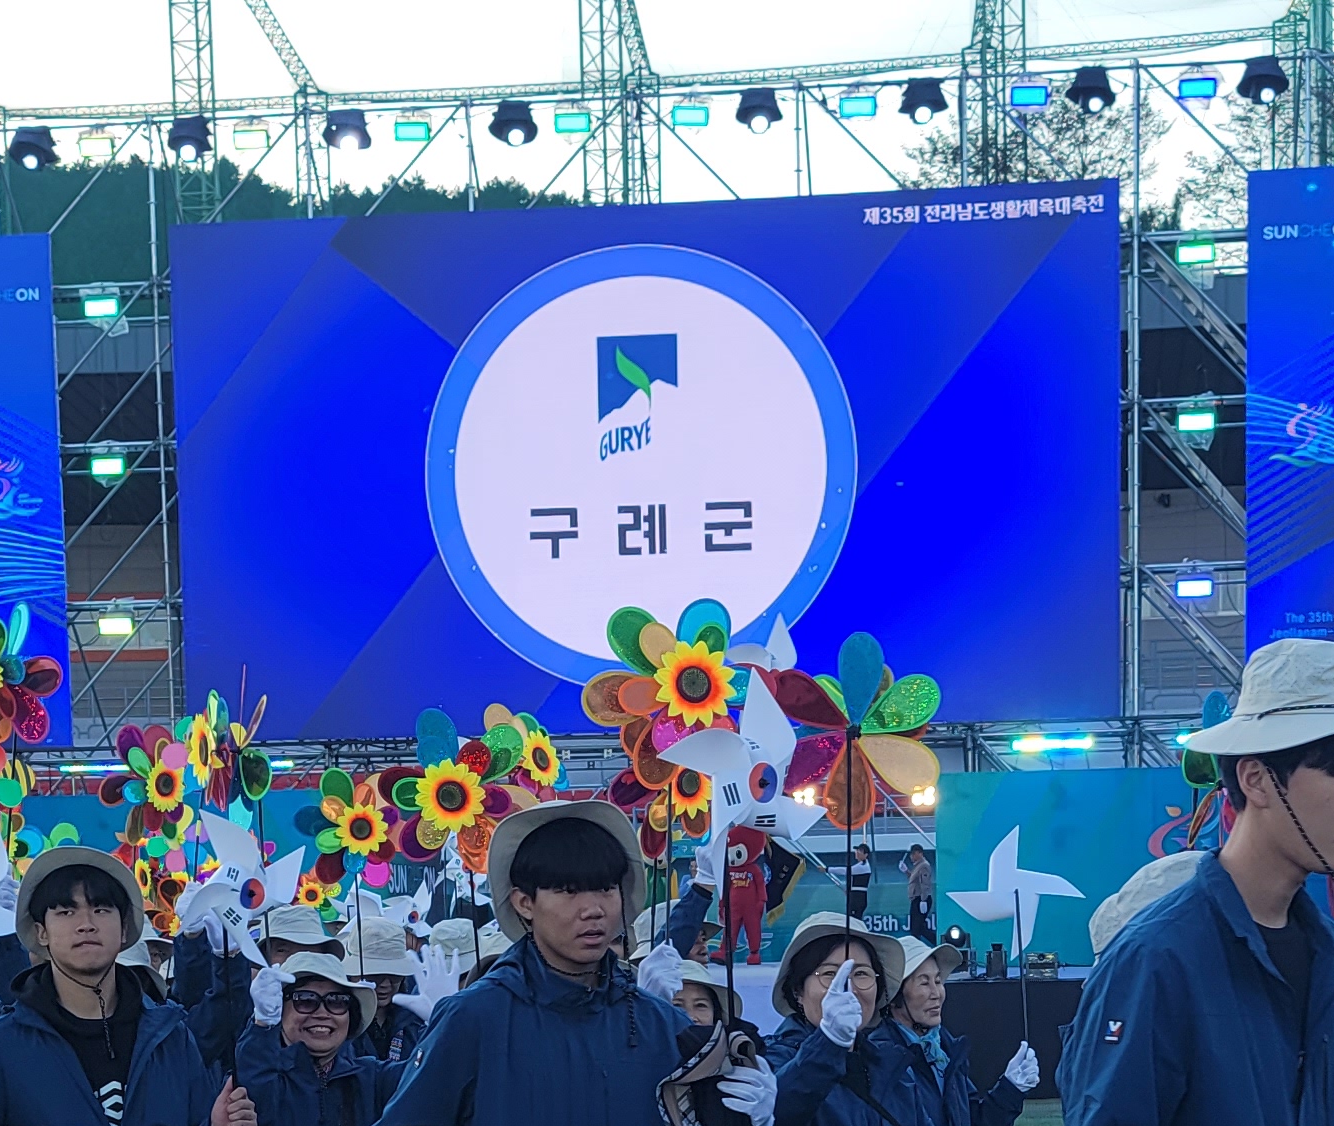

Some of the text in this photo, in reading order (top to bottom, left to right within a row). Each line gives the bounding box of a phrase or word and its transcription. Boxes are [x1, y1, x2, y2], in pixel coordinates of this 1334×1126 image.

[863, 194, 1105, 225] 제35회 전라남도생활체육대축전
[599, 416, 652, 462] GURYE
[1285, 611, 1334, 624] The 35th
